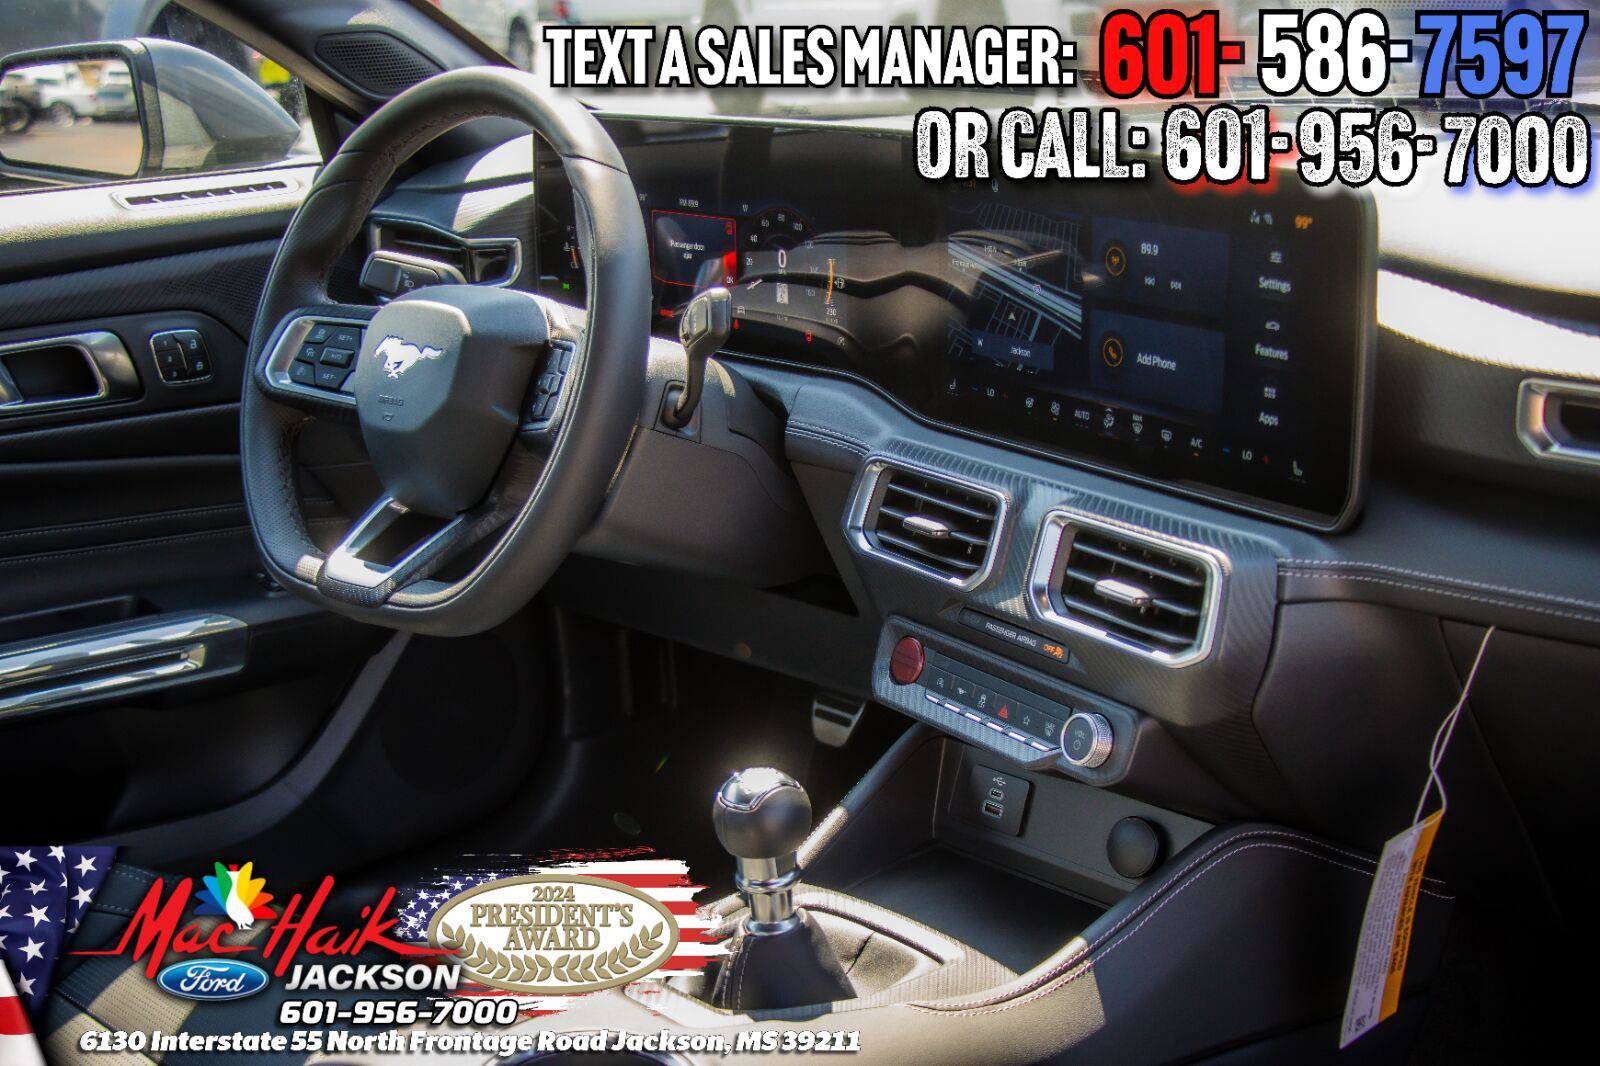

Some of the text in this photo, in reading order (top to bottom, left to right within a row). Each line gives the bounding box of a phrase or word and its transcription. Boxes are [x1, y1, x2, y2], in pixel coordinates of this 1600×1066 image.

[1140, 242, 1159, 256] 89.9
[778, 249, 787, 269] 0
[1258, 276, 1291, 293] Settings
[1010, 346, 1031, 357] Jackson
[1254, 343, 1288, 360] Features
[1136, 353, 1177, 371] Add Phone
[1074, 409, 1090, 421] AUTO
[1258, 411, 1279, 426] Apps
[1190, 437, 1203, 449] A/C
[1242, 450, 1252, 461] LO
[985, 622, 1017, 639] PASSENGER
[1017, 635, 1037, 647] AIRBAG
